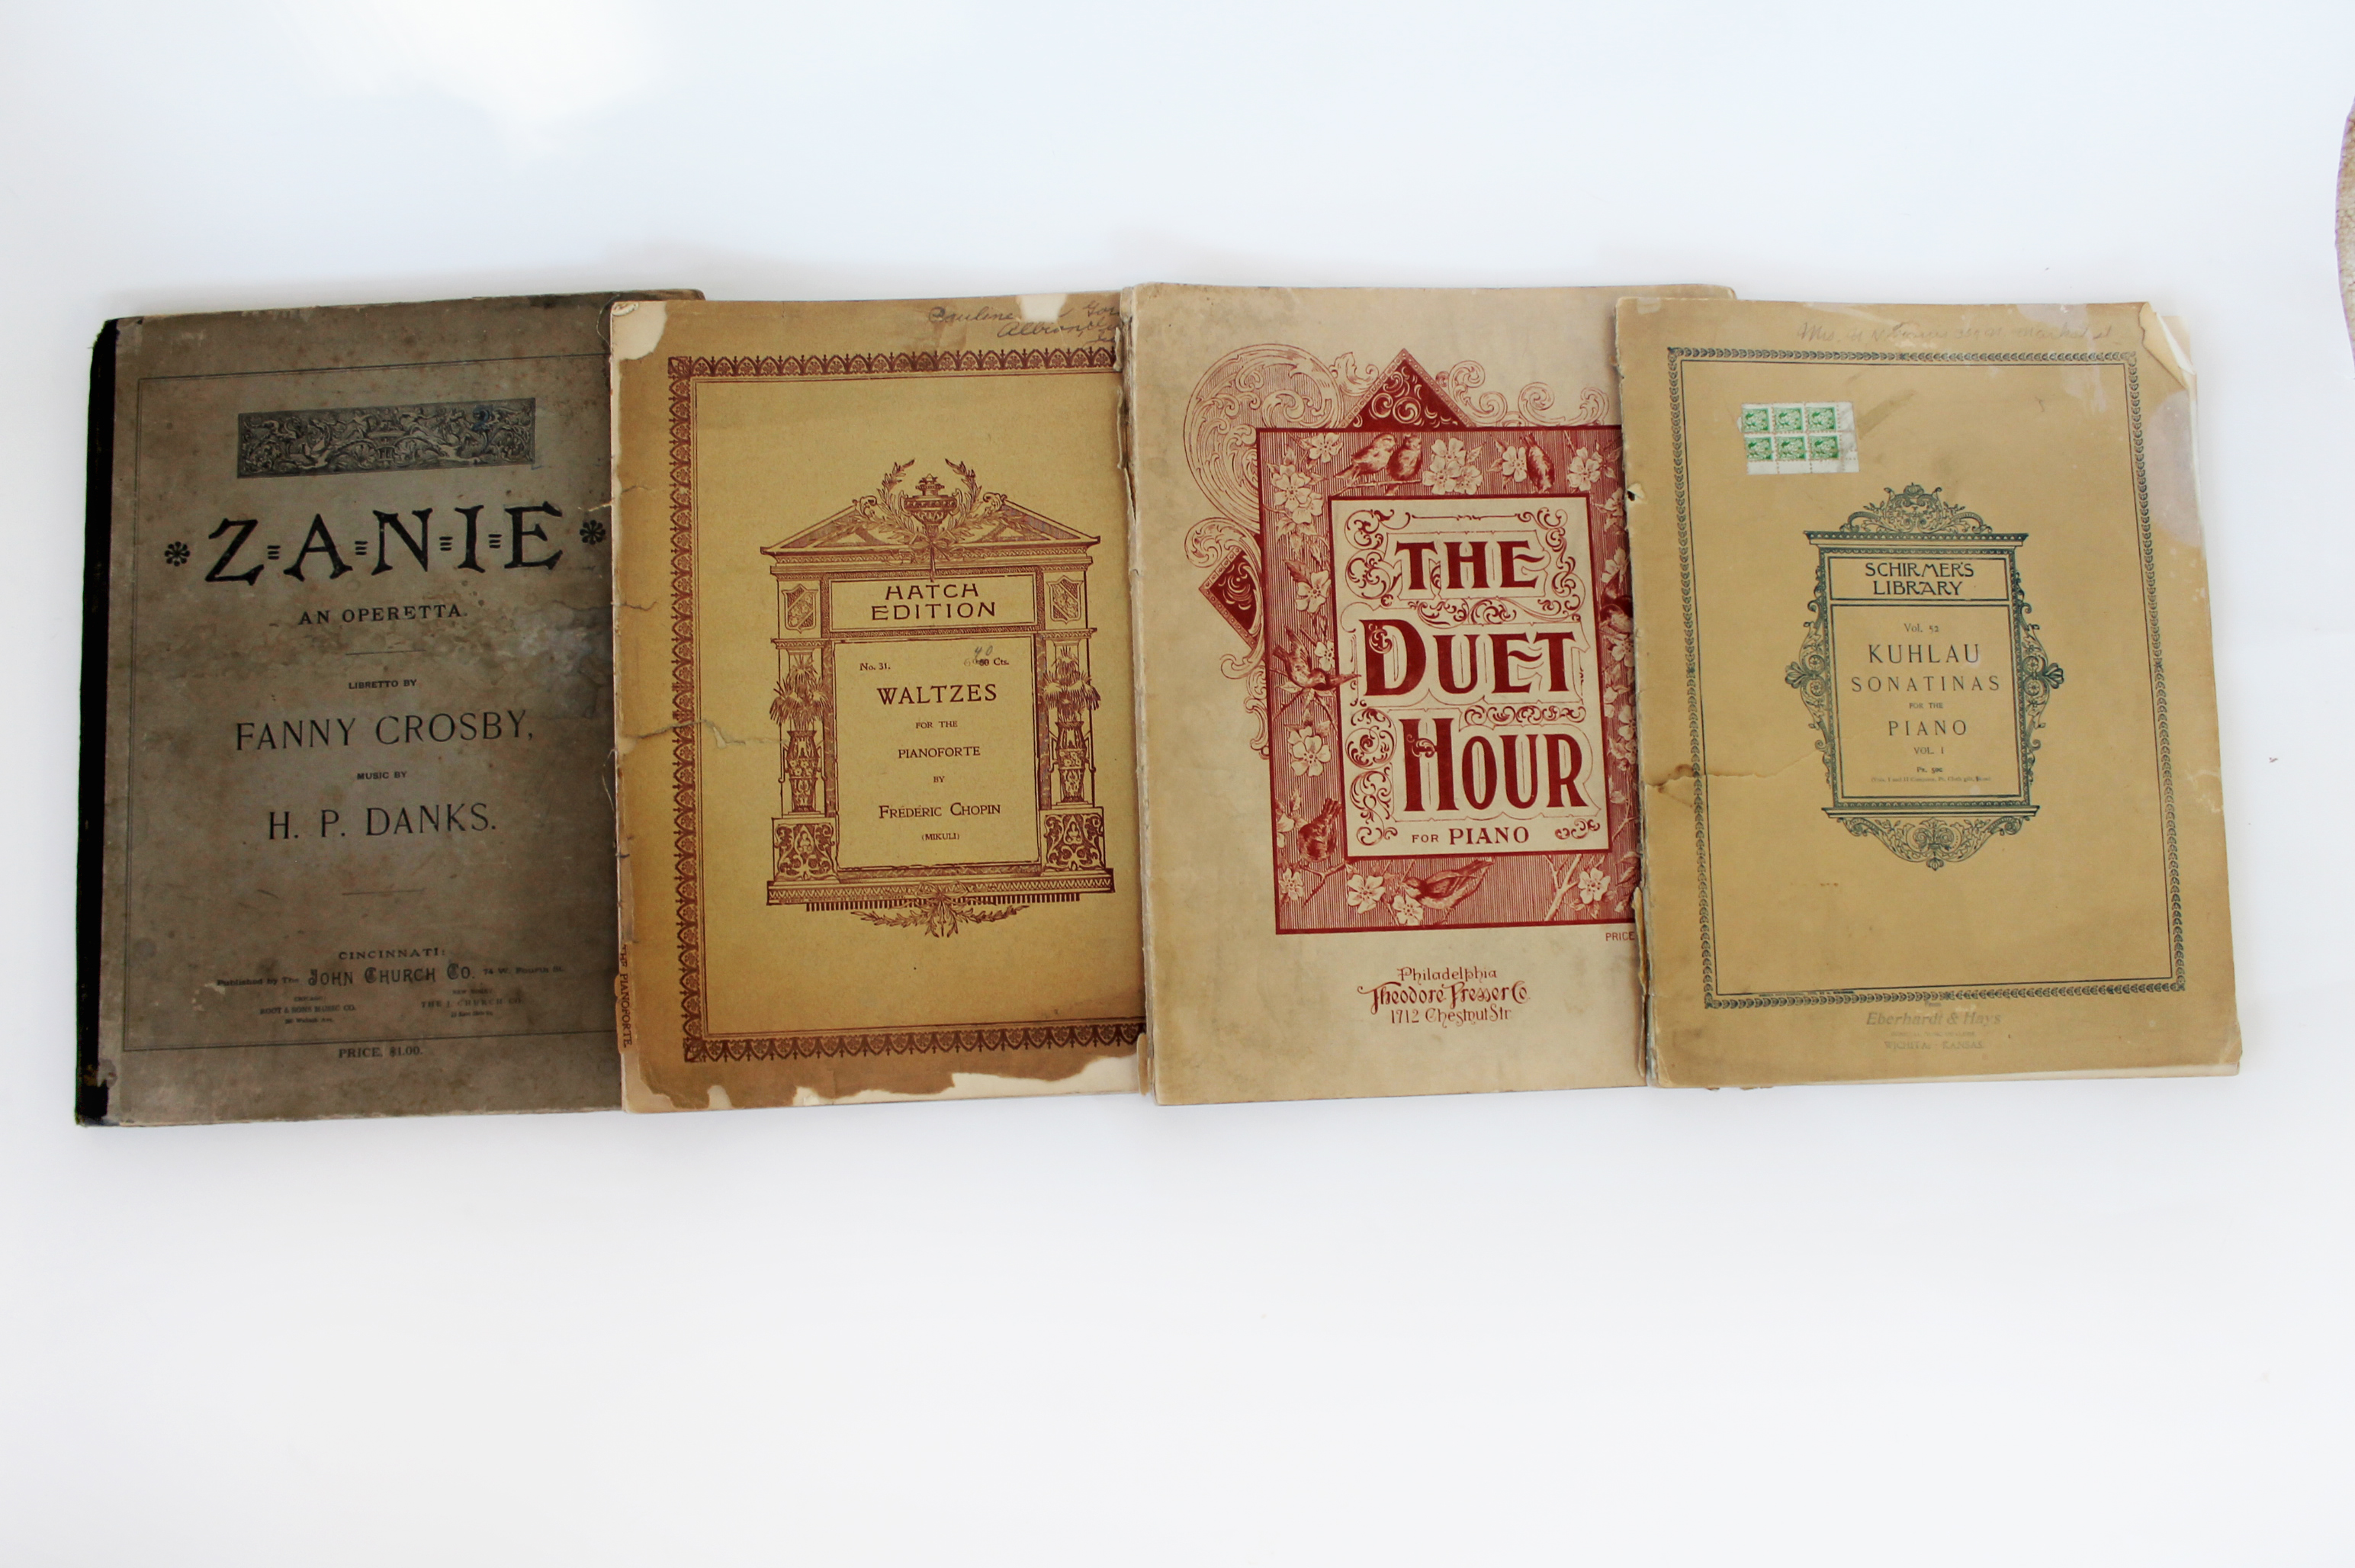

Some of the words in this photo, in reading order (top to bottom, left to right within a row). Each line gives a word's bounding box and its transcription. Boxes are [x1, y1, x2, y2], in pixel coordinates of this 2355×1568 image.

[1395, 540, 1545, 590] THE
[1865, 562, 1974, 577] SCHIRMER'S
[885, 583, 979, 600] HATCH
[1873, 580, 1963, 596] LIBRARY
[298, 610, 331, 625] AN
[871, 601, 996, 621] EDITION
[1904, 623, 1923, 632] Vol.
[1929, 624, 1939, 632] 52
[994, 657, 1010, 666] Cts.
[1358, 618, 1576, 696] DUET
[1868, 644, 1979, 664] KUHLAU
[859, 663, 876, 671] No.
[349, 680, 399, 689] LIBRETTO
[1851, 675, 2000, 692] SONATINAS
[876, 683, 998, 705] WALTZES
[236, 718, 356, 750] FANNY
[375, 709, 533, 745] CROSBY,
[1888, 720, 1967, 736] PIANO
[898, 746, 981, 759] PIANOFORTE
[1399, 718, 1589, 812] HOUR
[950, 802, 1001, 816] CHOPIN
[269, 811, 299, 839] H.
[321, 809, 345, 837] P.
[366, 802, 496, 836] DANKS.
[921, 833, 960, 841] (MIKULI)
[1412, 834, 1439, 843] FOR
[1449, 826, 1530, 845] PIANO
[1605, 932, 1635, 941] PRICE
[1397, 966, 1498, 985] Philadelphia
[1357, 981, 1446, 1015] Theodore
[1866, 1012, 1943, 1025] Eberhardt
[1946, 1013, 1959, 1025] &
